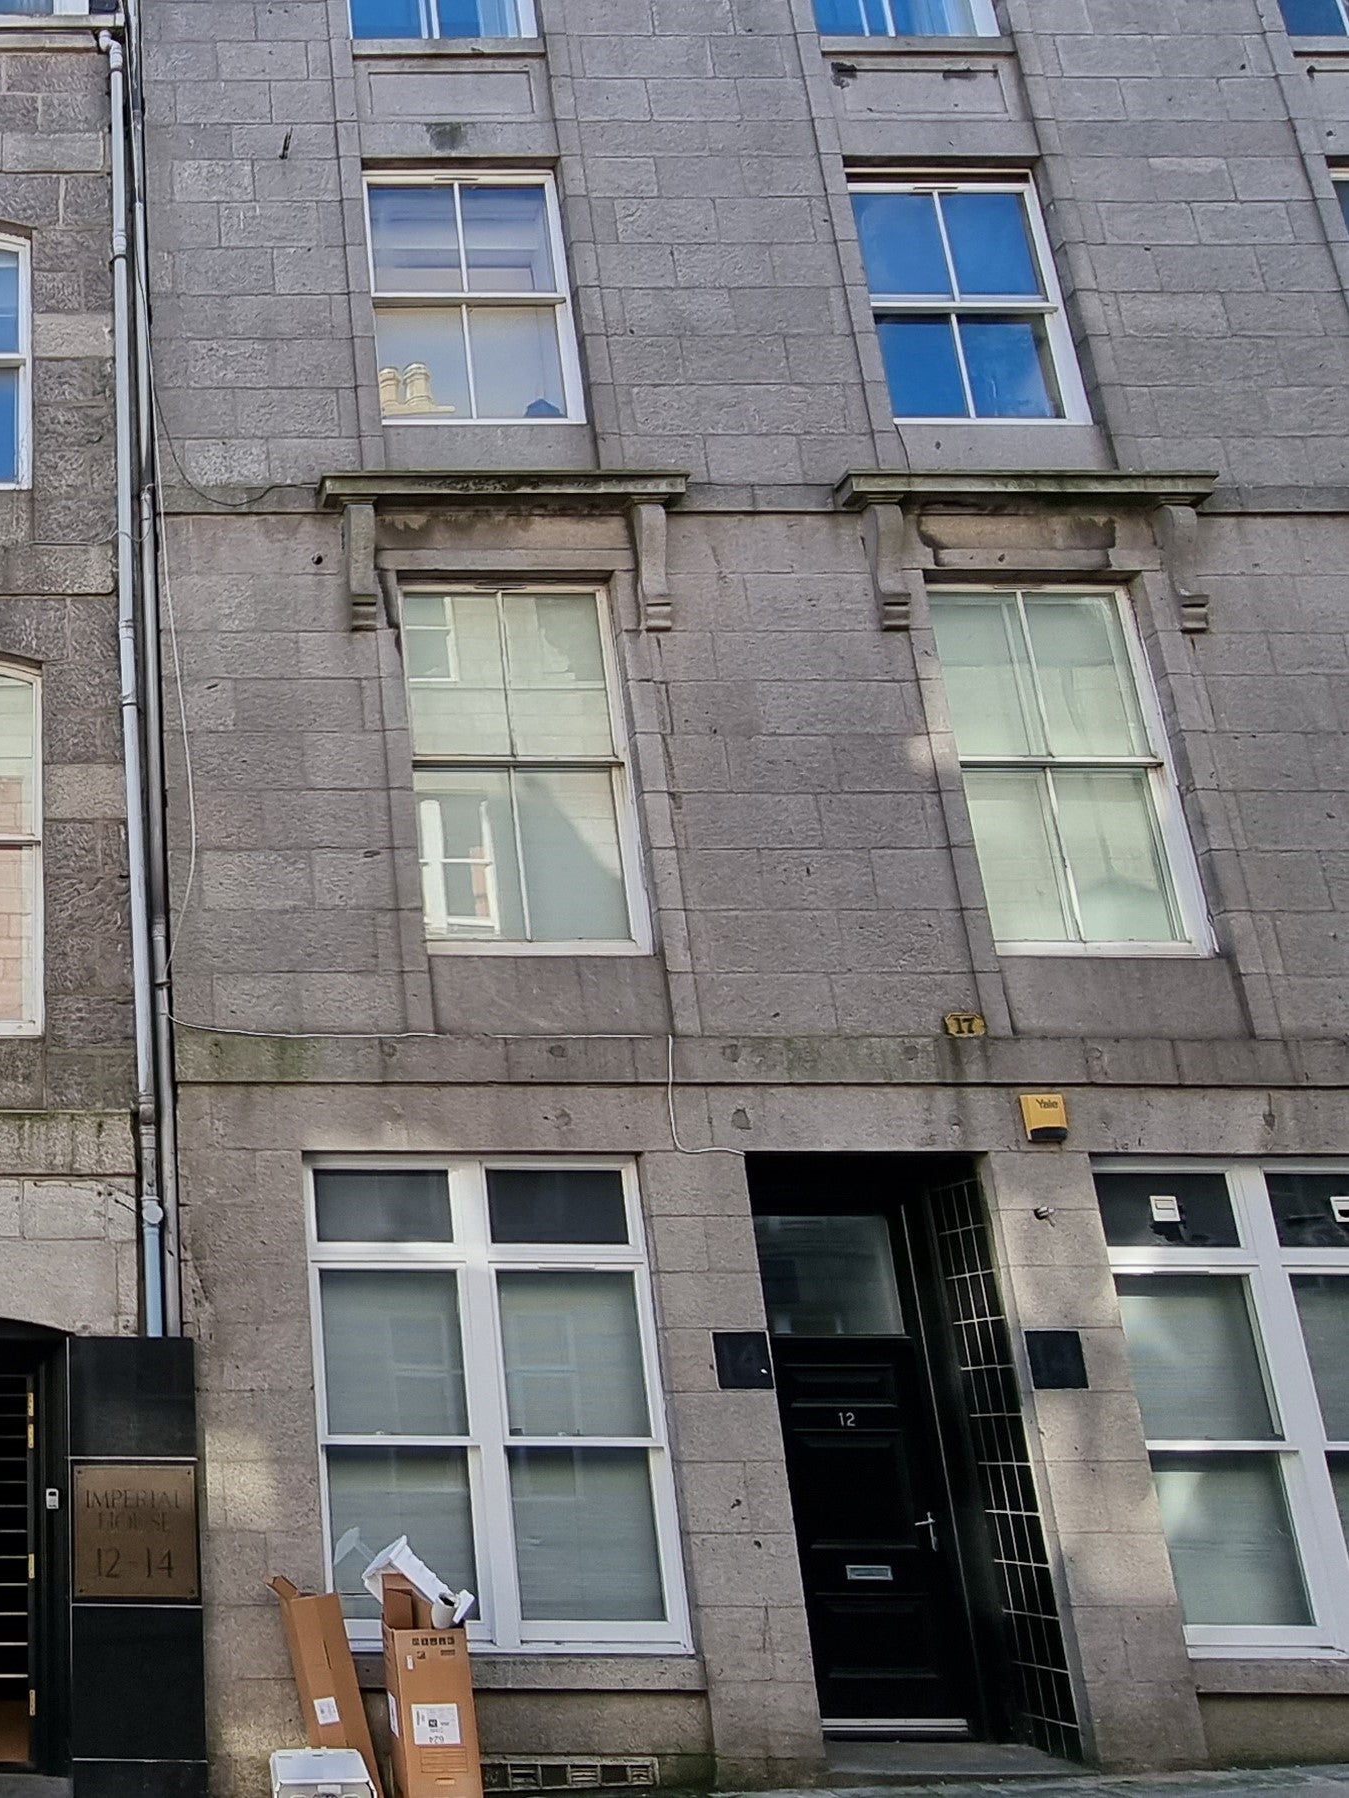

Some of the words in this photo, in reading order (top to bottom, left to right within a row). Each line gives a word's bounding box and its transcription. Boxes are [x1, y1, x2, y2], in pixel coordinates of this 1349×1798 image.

[953, 1017, 975, 1034] 17
[1035, 1098, 1058, 1109] Yale
[838, 1411, 856, 1427] 12
[86, 1489, 180, 1509] IMPERIAL
